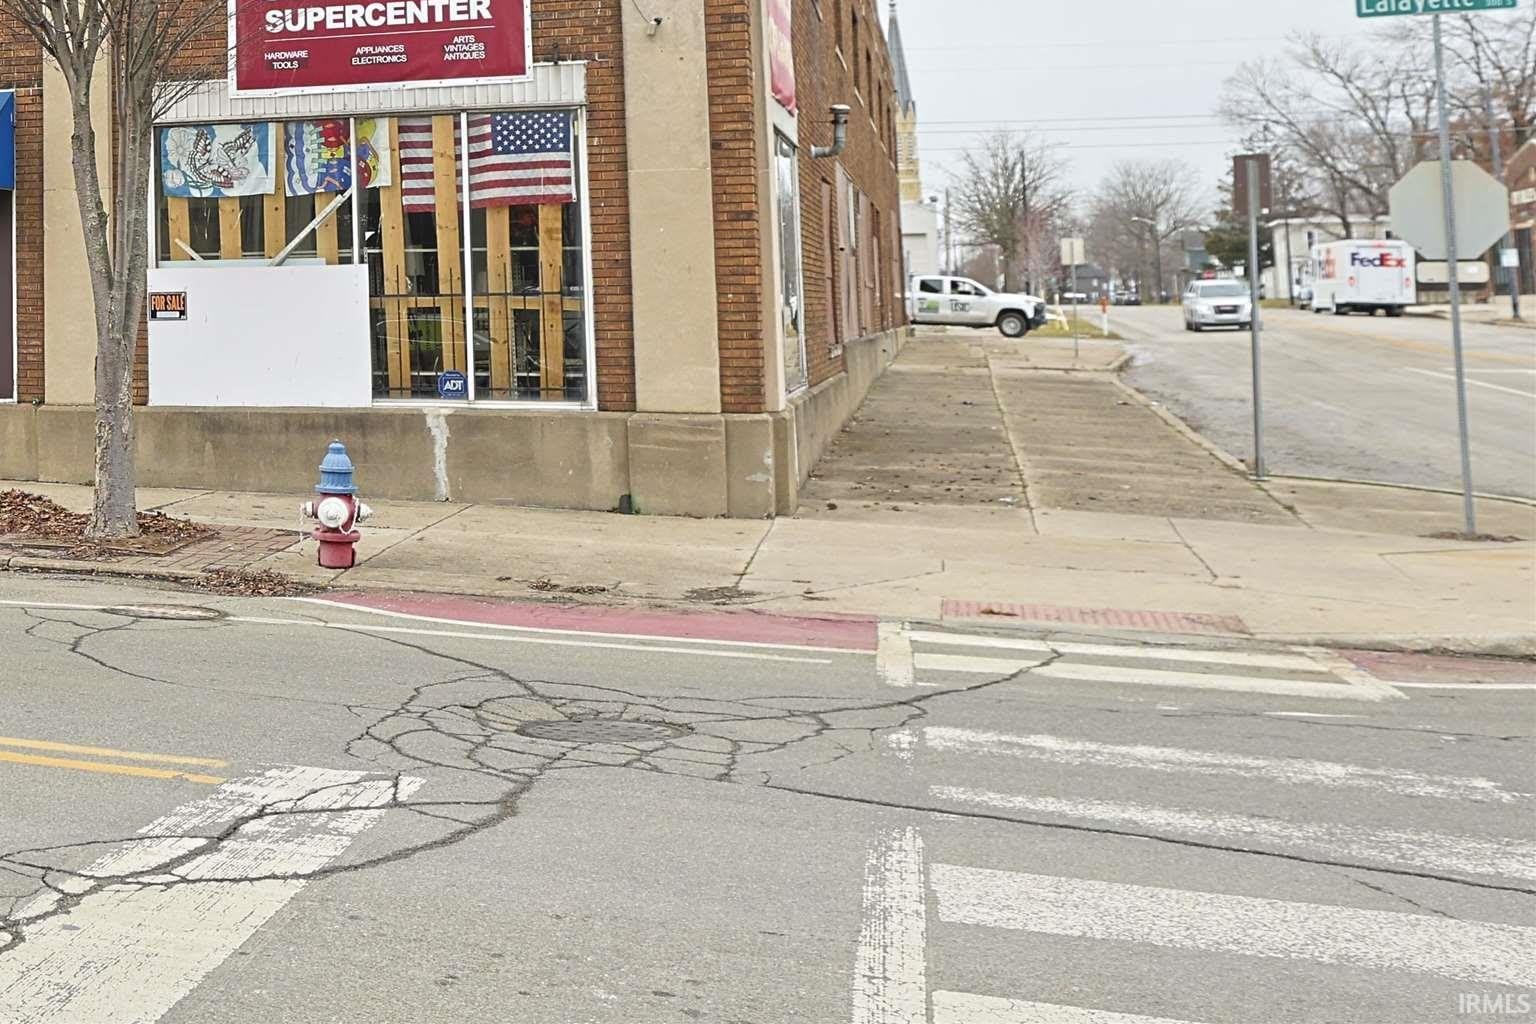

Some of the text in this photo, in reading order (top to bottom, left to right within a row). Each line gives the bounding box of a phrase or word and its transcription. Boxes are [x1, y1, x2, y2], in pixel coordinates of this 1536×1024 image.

[452, 34, 476, 45] ARTS
[355, 44, 405, 55] APPLIANCES
[443, 42, 485, 53] VINTAGES
[264, 49, 309, 60] HARDWARE
[351, 54, 407, 66] ELECTRONICS
[443, 51, 485, 61] ANTIQUES
[272, 60, 299, 70] TOOLS
[1351, 252, 1406, 267] FedEx
[152, 295, 184, 311] FOR SALE
[443, 380, 464, 391] ADT
